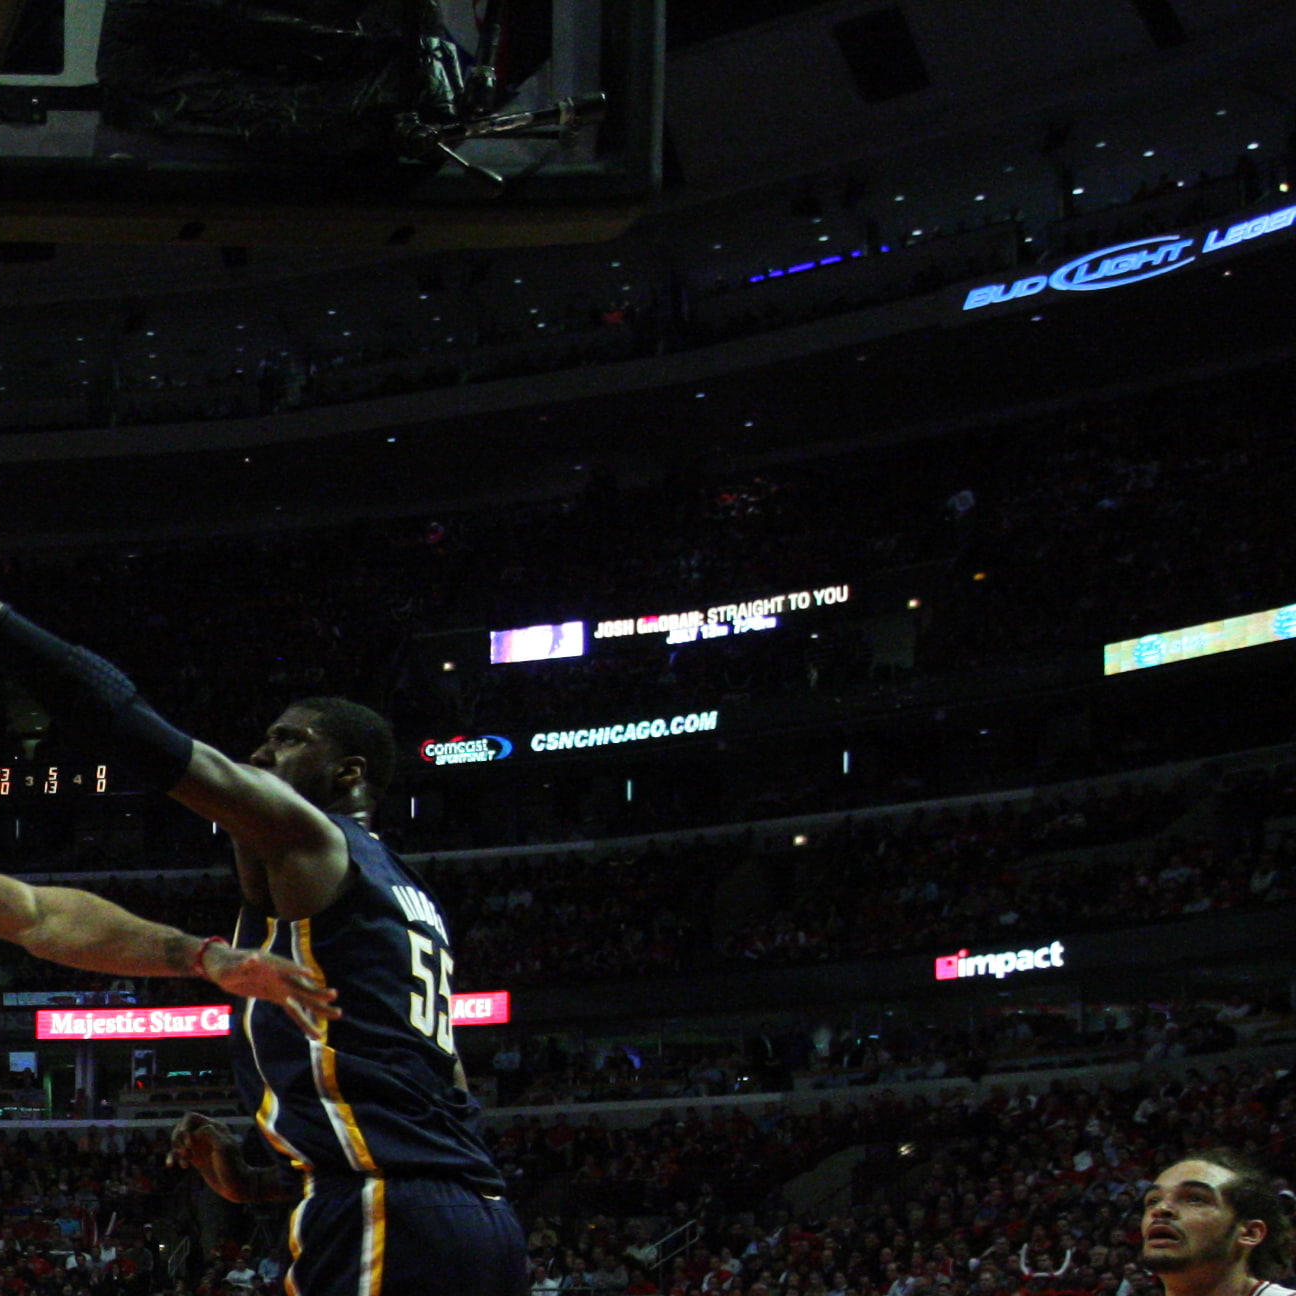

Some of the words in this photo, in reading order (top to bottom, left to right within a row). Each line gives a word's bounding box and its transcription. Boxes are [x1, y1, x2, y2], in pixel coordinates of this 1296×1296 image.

[963, 275, 1049, 310] BUD
[1073, 239, 1194, 285] LIGHT
[594, 618, 634, 638] JOSH
[707, 595, 785, 624] STRAIGHT
[788, 590, 810, 611] TO
[814, 585, 849, 606] YOU
[425, 738, 488, 757] comcast
[531, 711, 718, 751] CSNCHICAGO.COM
[44, 780, 58, 794] 13
[48, 766, 58, 781] 5
[958, 940, 1065, 979] impact
[408, 929, 455, 1055] 55
[451, 998, 492, 1018] ACE!
[50, 1010, 145, 1039] Majestic
[150, 1009, 197, 1034] Star
